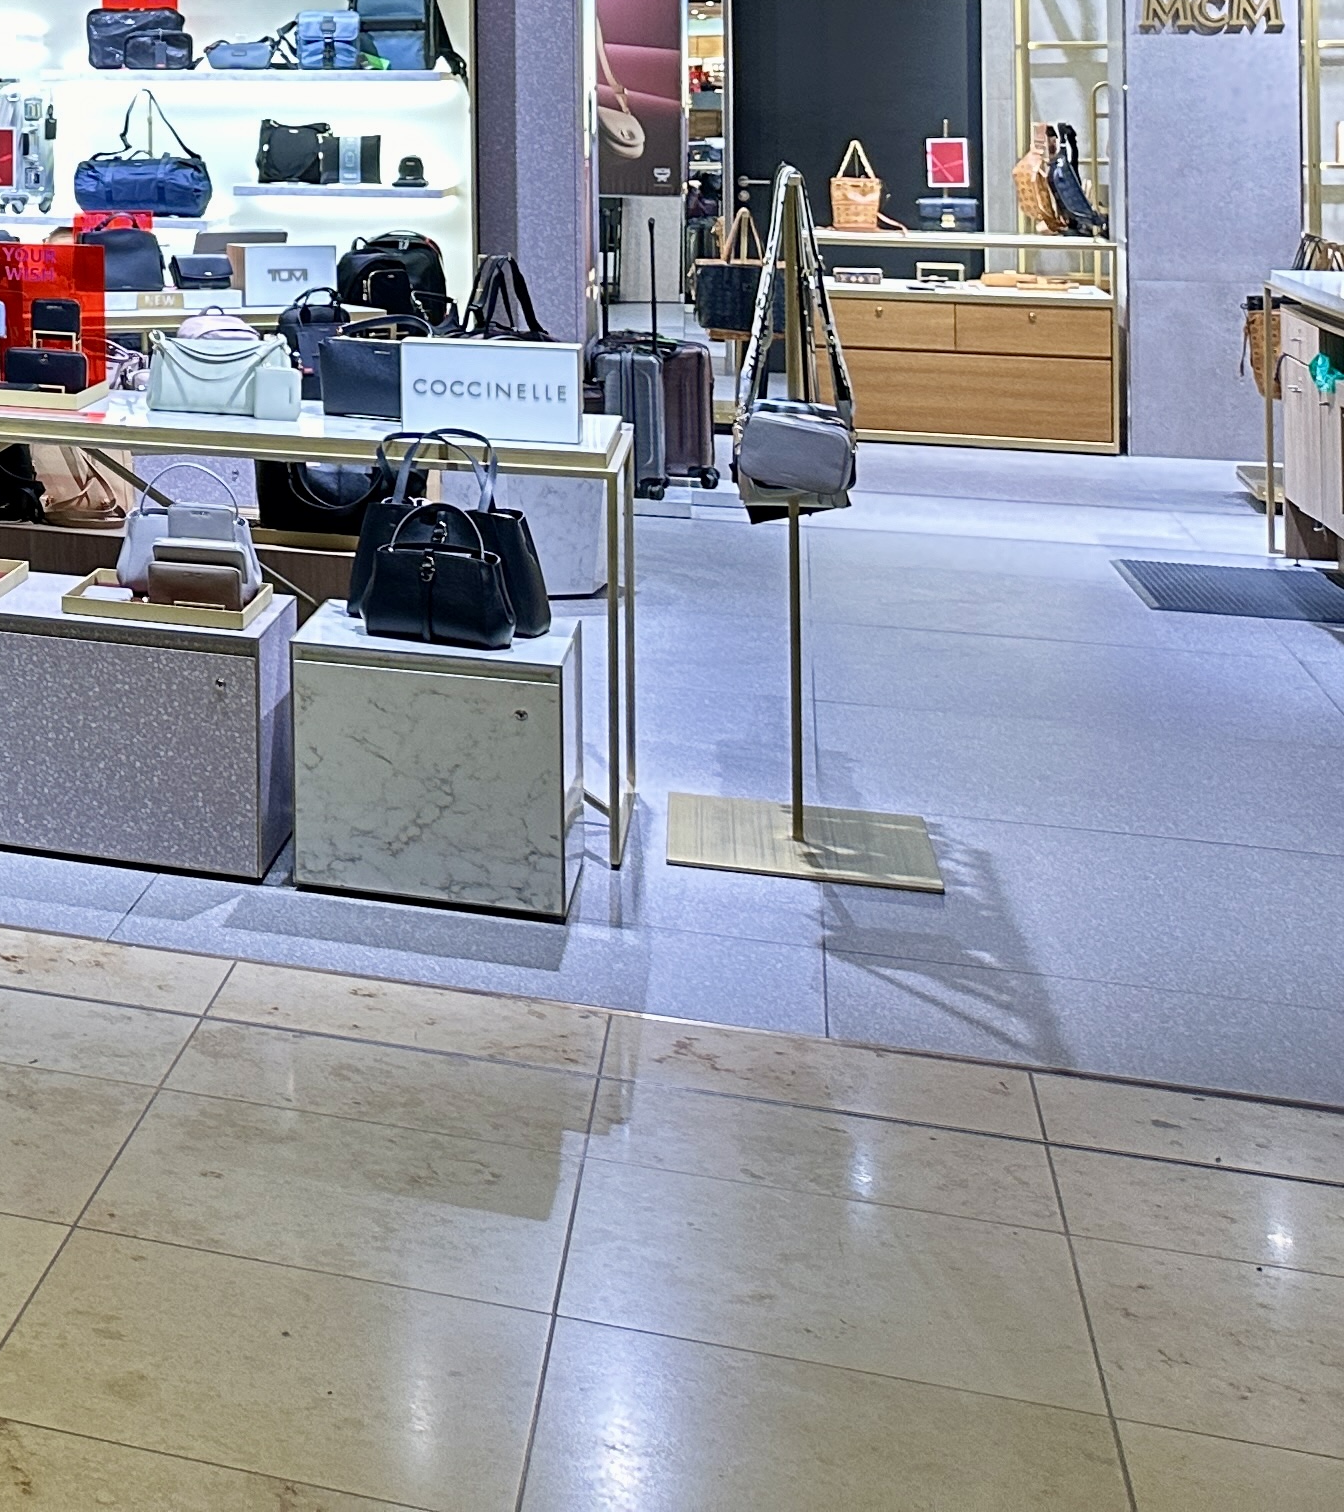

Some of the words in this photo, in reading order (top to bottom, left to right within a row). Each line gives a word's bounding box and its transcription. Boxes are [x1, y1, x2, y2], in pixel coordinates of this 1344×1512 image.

[2, 247, 56, 264] YOUR
[5, 266, 55, 281] WISH
[267, 268, 307, 282] TUMI
[144, 294, 175, 306] NEW
[413, 379, 567, 402] COCCINELLE
